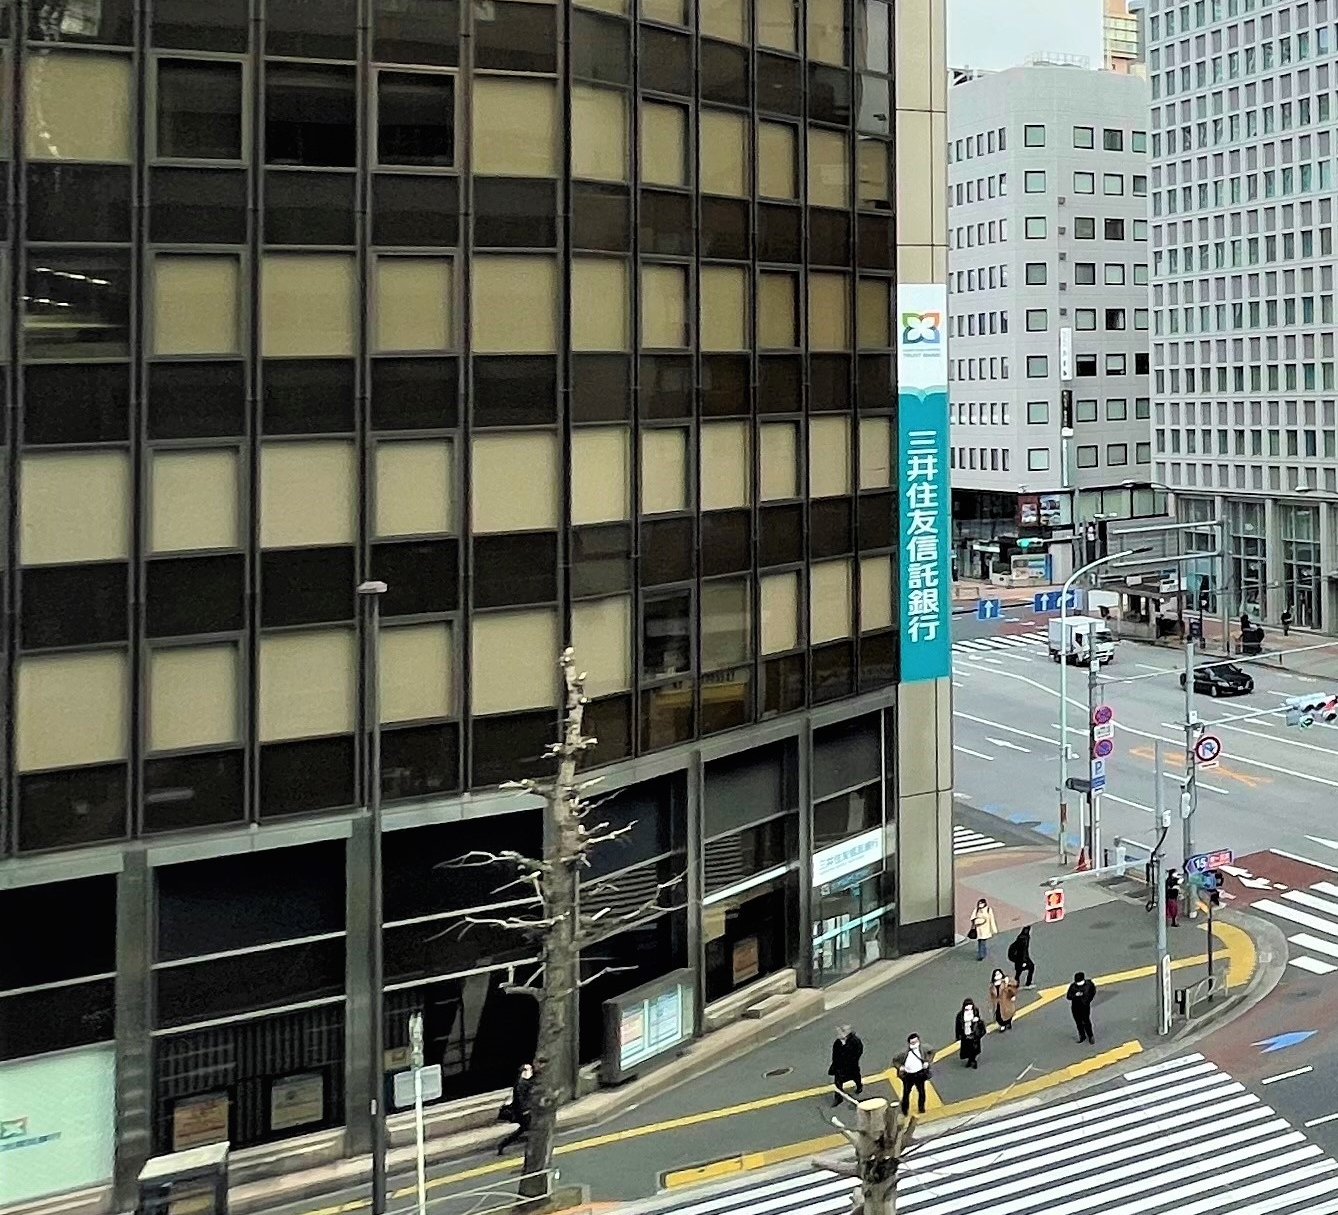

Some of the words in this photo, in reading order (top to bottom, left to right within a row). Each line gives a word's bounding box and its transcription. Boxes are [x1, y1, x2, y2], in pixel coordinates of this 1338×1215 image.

[906, 429, 940, 644] 三井住友信託銀行
[1194, 857, 1207, 869] 15
